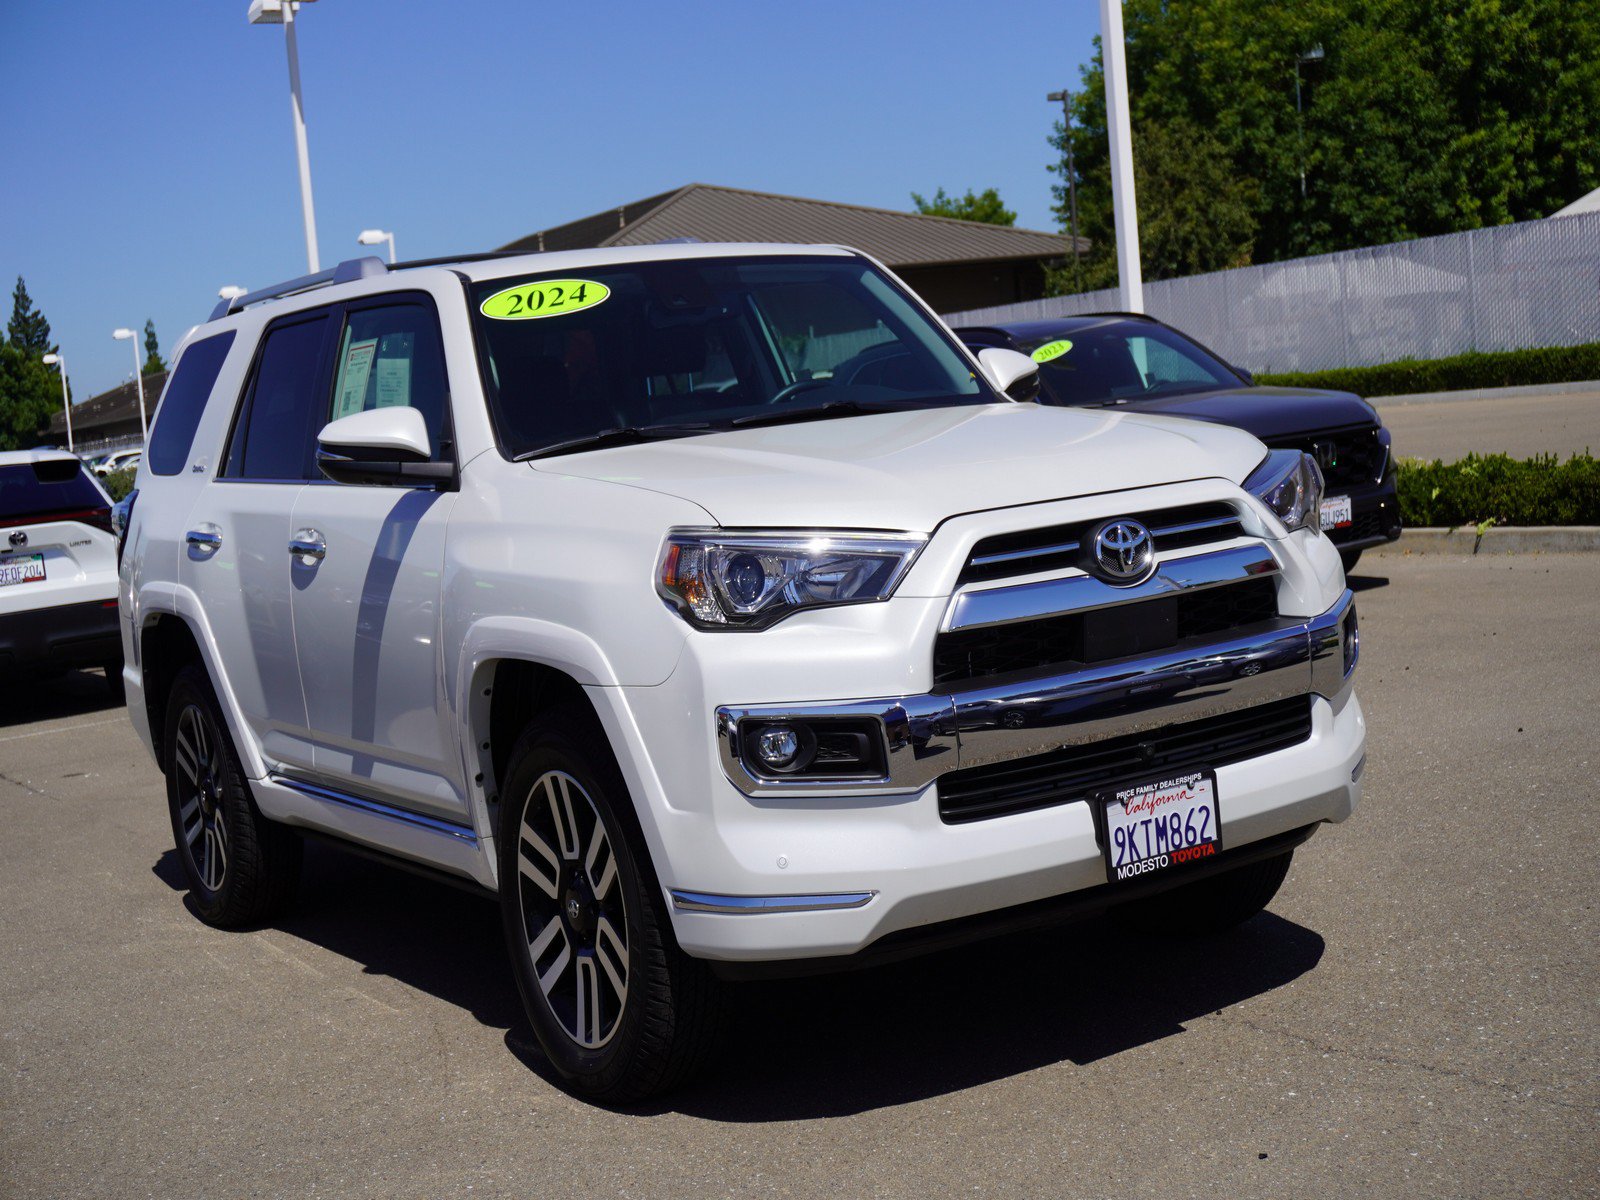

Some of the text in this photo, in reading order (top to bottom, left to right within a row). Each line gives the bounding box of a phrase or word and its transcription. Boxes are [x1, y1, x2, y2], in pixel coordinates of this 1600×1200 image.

[506, 283, 588, 316] 2024
[1116, 772, 1202, 800] PRICE FAMILY DEALERSHIPS
[1125, 788, 1195, 816] California
[1114, 805, 1213, 868] 9KTM862
[1117, 843, 1215, 880] MODESTO TOYOTA
